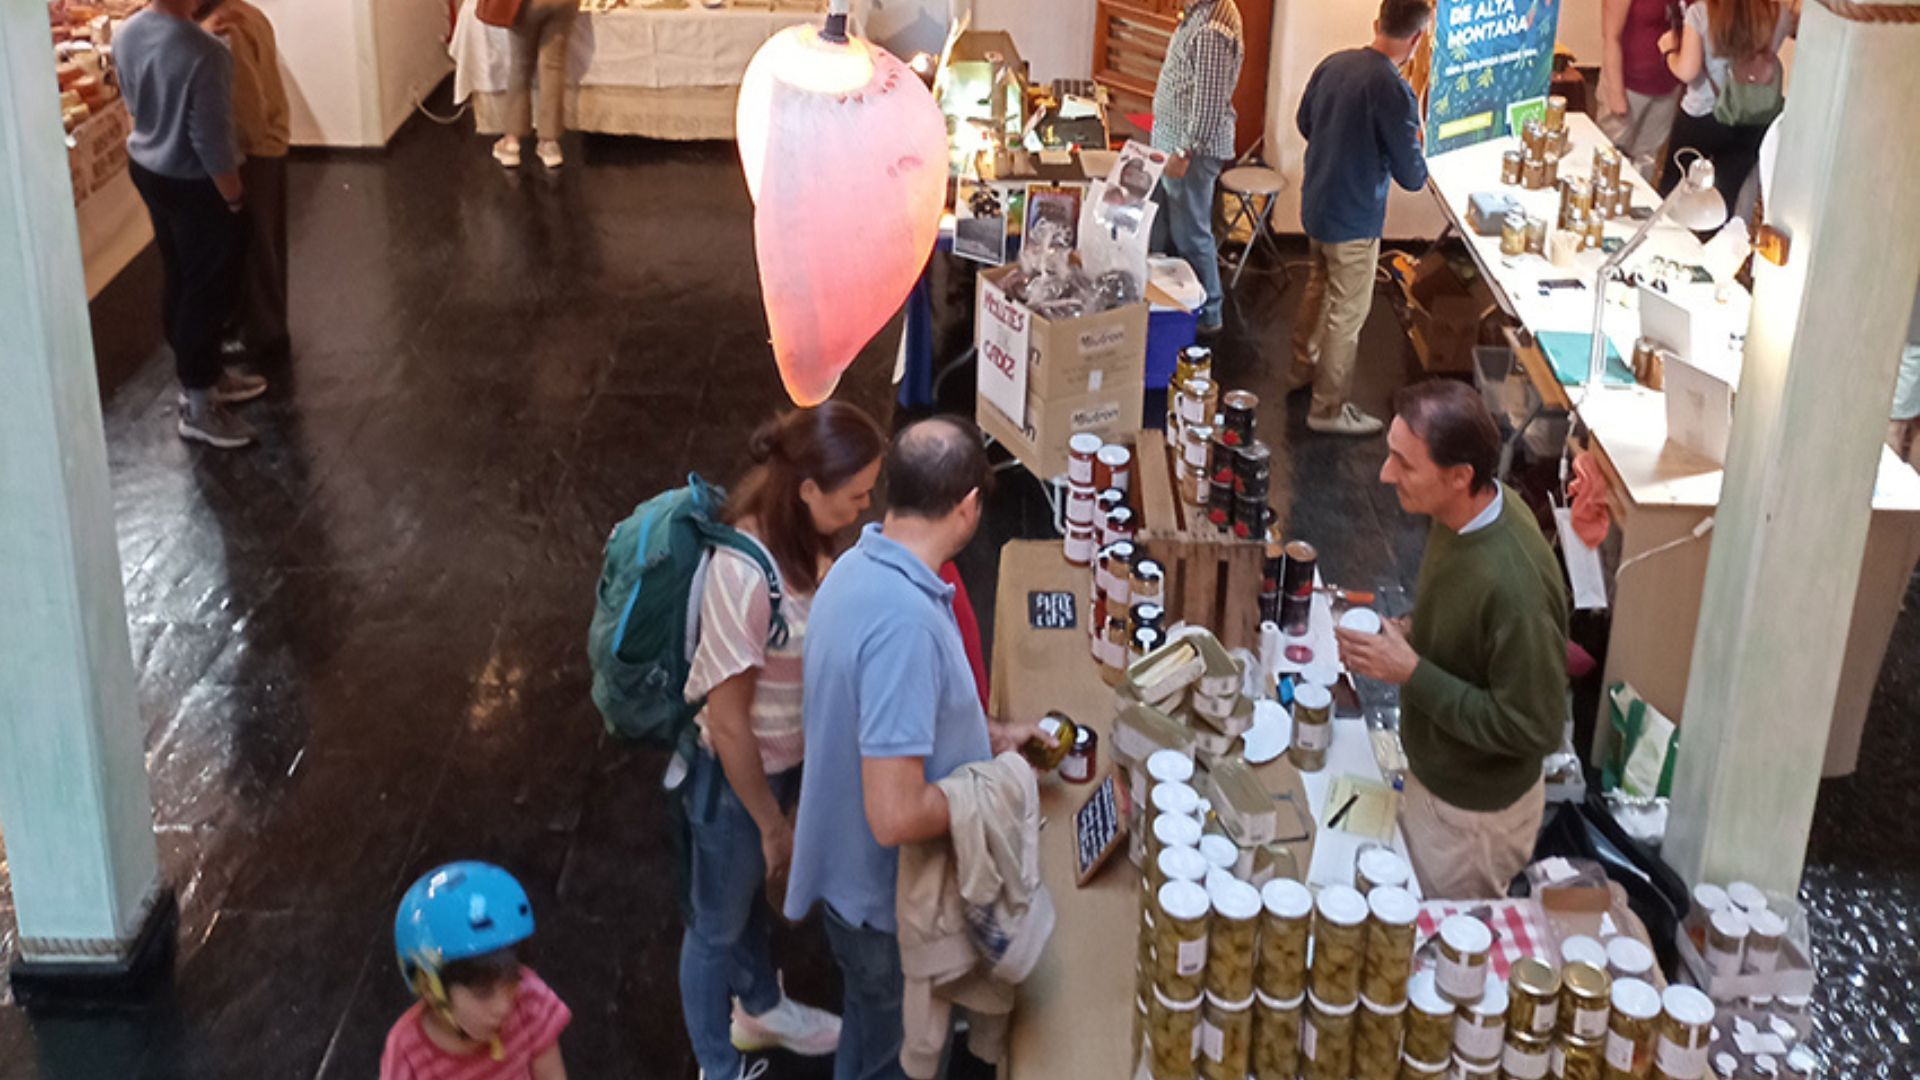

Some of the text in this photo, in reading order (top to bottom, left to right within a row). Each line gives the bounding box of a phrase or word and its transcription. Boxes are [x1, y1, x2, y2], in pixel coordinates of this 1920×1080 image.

[1449, 0, 1515, 26] DE ALTA
[1447, 14, 1529, 49] MONTAÑA
